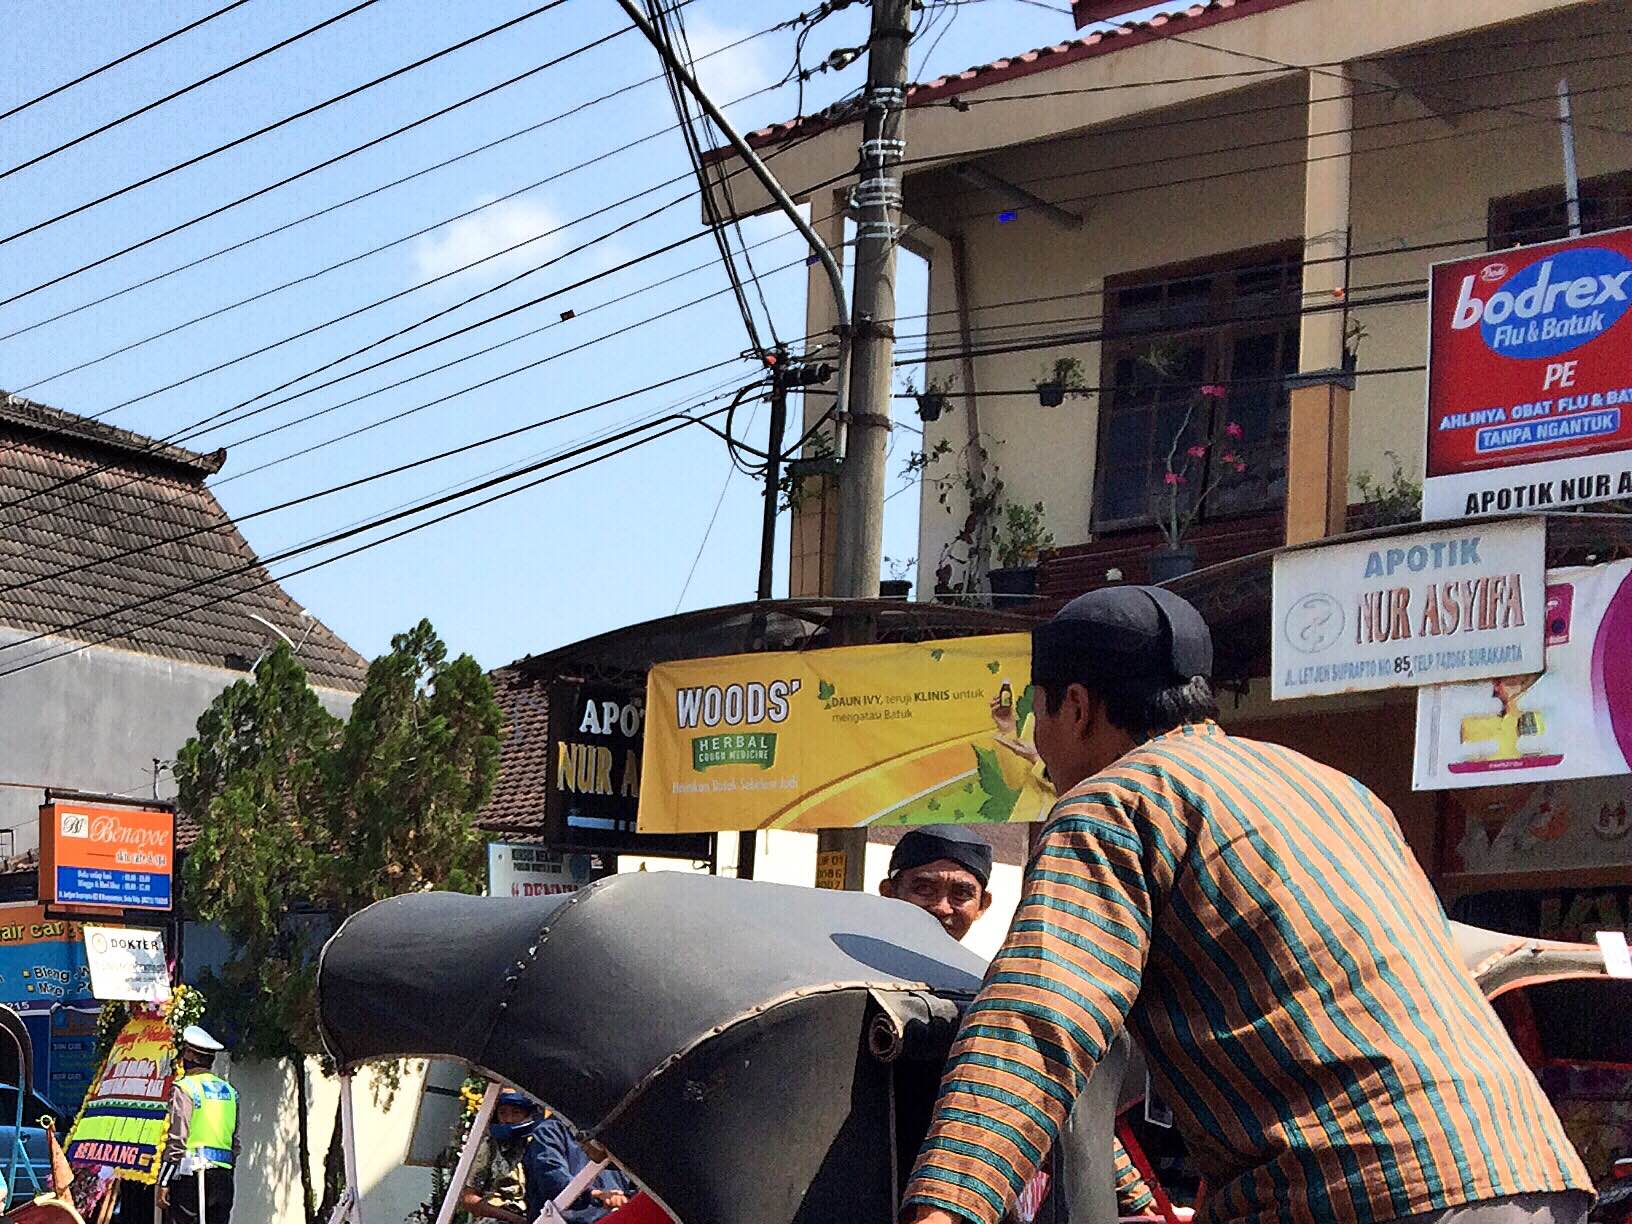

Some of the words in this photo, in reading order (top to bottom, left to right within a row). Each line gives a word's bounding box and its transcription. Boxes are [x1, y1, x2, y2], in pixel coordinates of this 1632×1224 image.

[1451, 260, 1631, 329] bodrex
[1494, 325, 1525, 348] Flu
[1527, 320, 1539, 342] &
[1542, 310, 1605, 340] Batuk
[1542, 360, 1579, 391] PE
[1439, 408, 1506, 431] AHLINYA
[1511, 401, 1552, 419] OBAT
[1558, 395, 1588, 412] FLU
[1592, 393, 1603, 407] &
[1483, 428, 1533, 447] TANPA
[1537, 414, 1613, 440] NGANTUK
[1465, 482, 1555, 515] APOTIK
[1560, 474, 1610, 501] NUR
[1364, 537, 1481, 578] APOTIK
[1356, 587, 1411, 645] NUR
[1419, 573, 1525, 638] ASYIFA
[832, 696, 860, 707] DAUN
[864, 694, 883, 705] IVY,
[914, 690, 950, 702] KLINIS
[952, 688, 984, 700] untuk
[579, 699, 644, 738] APO
[699, 751, 726, 763] COUGH
[729, 750, 768, 760] MEDICINE
[700, 736, 768, 751] HERBAL
[557, 741, 613, 795] NUR
[89, 815, 168, 847] Benayoe
[111, 938, 159, 951] DOKTER
[74, 1142, 139, 1165] SEMARANG
